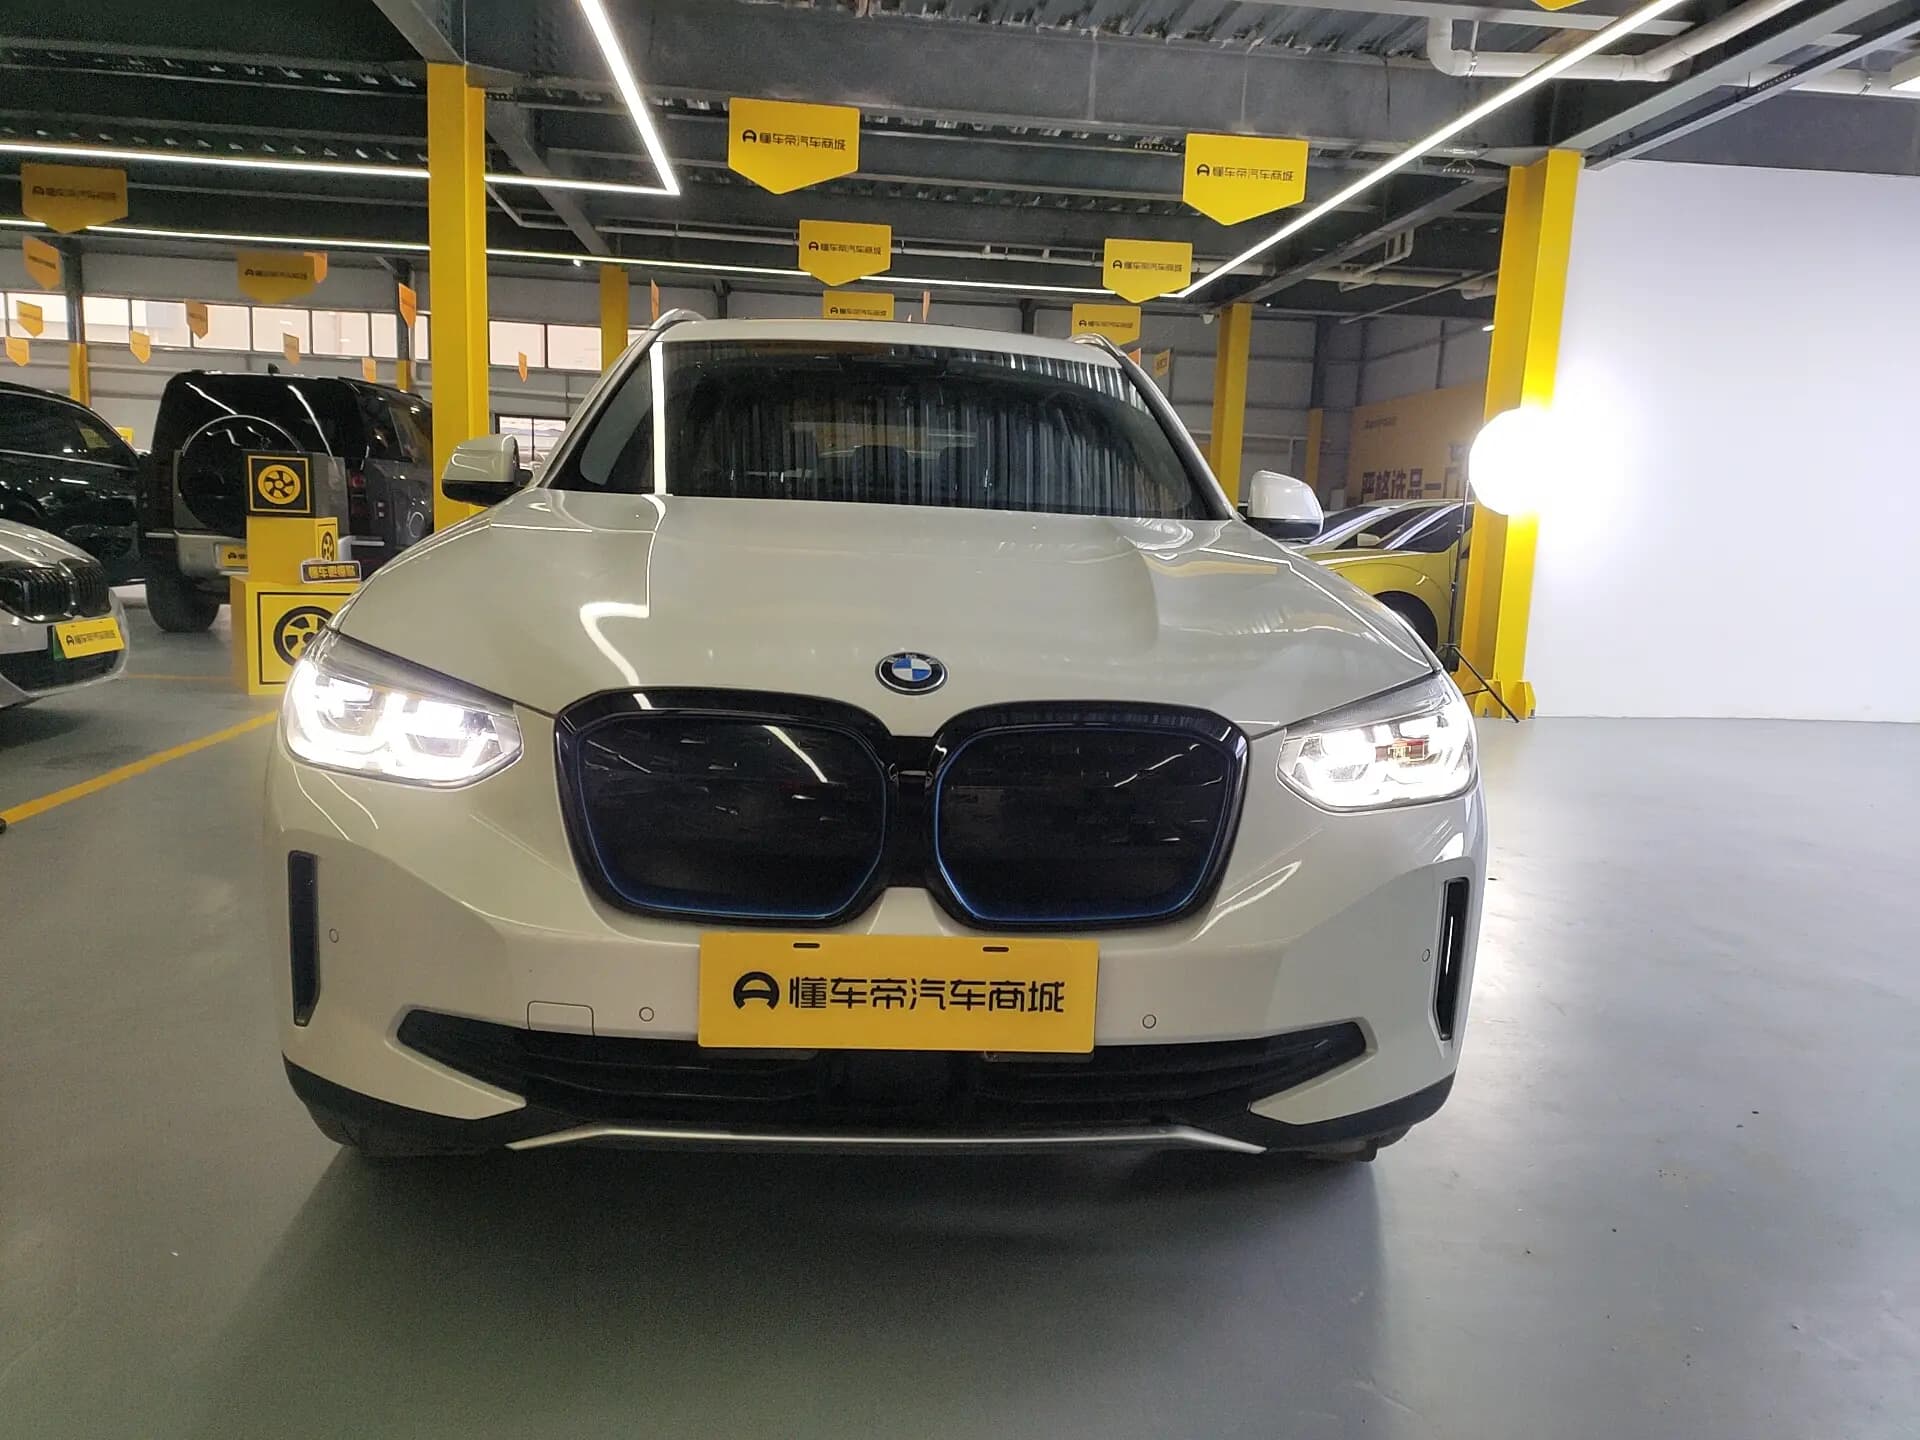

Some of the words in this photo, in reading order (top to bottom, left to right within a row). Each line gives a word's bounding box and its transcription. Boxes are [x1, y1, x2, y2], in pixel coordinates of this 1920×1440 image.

[789, 976, 1065, 1014] 懂车帝汽车商城
